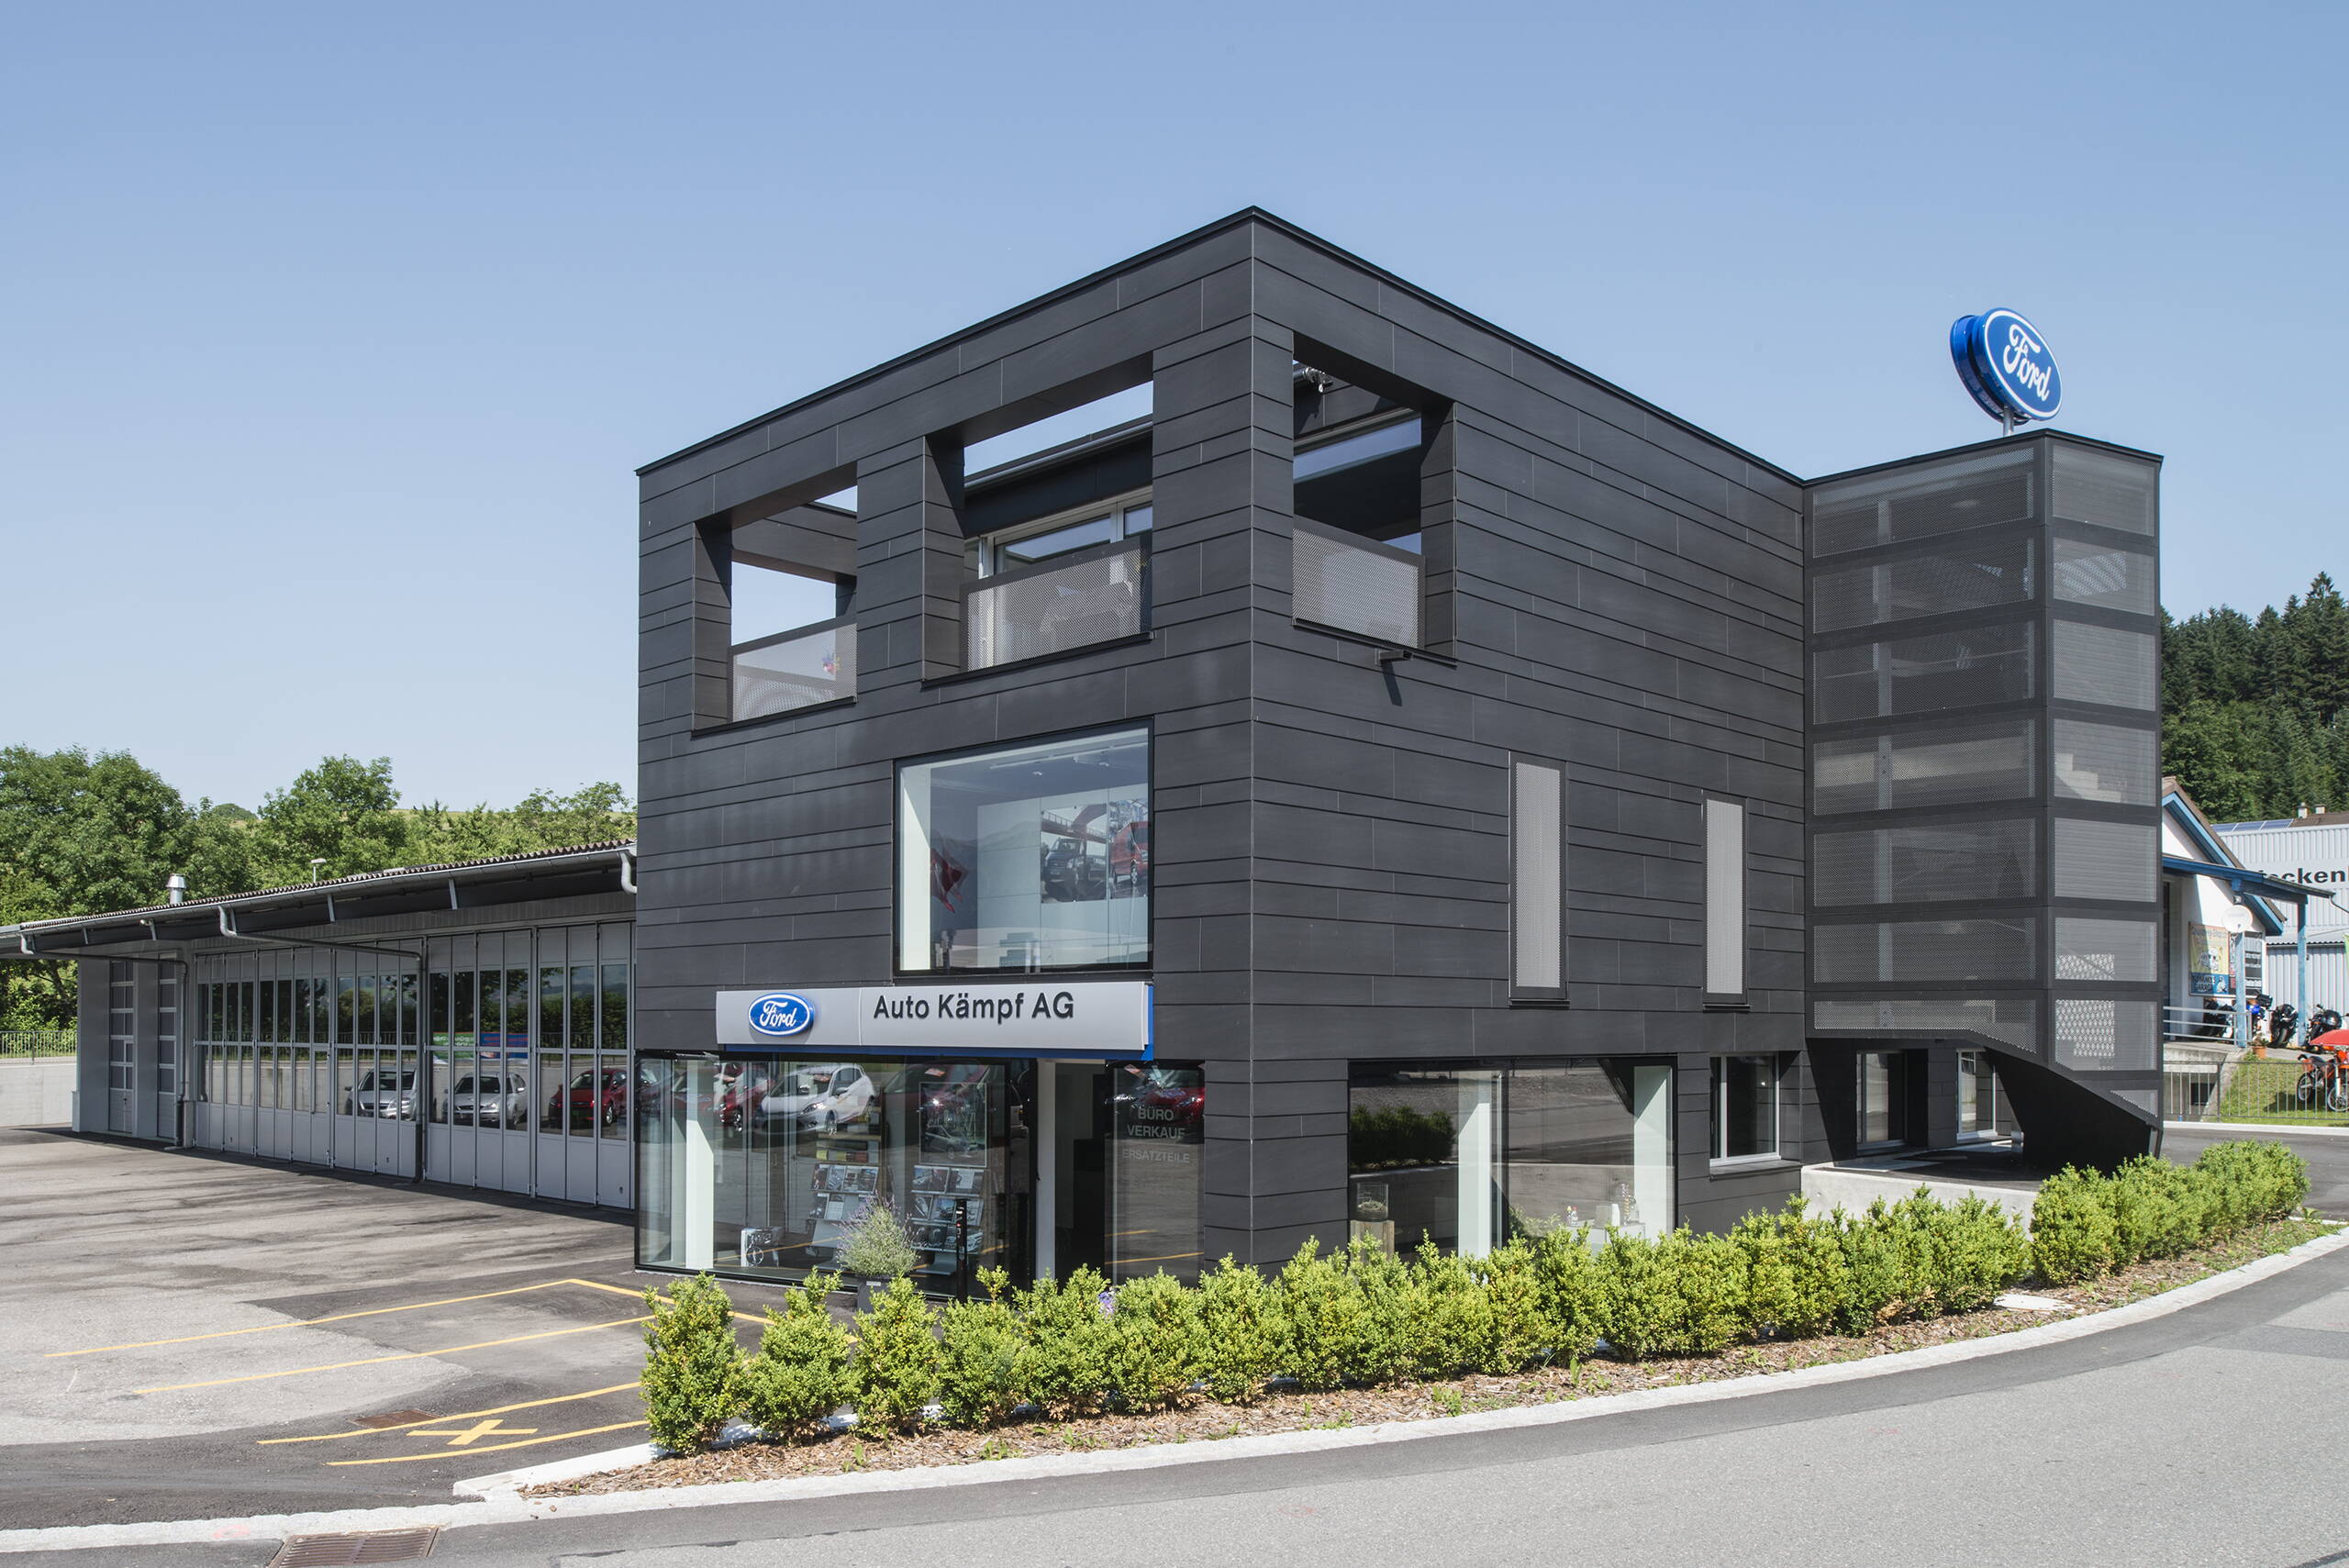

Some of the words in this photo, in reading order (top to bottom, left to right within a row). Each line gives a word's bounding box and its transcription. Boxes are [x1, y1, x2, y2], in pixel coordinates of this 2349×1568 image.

[2003, 323, 2052, 402] Ford
[760, 1000, 797, 1027] Ford
[874, 995, 930, 1019] Auto
[938, 992, 1025, 1025] Kämpf
[1031, 991, 1074, 1019] AG
[1138, 1106, 1174, 1121] BÜRO
[1127, 1124, 1186, 1139] VERKAUF
[1122, 1148, 1190, 1163] ERSATZTEILE
